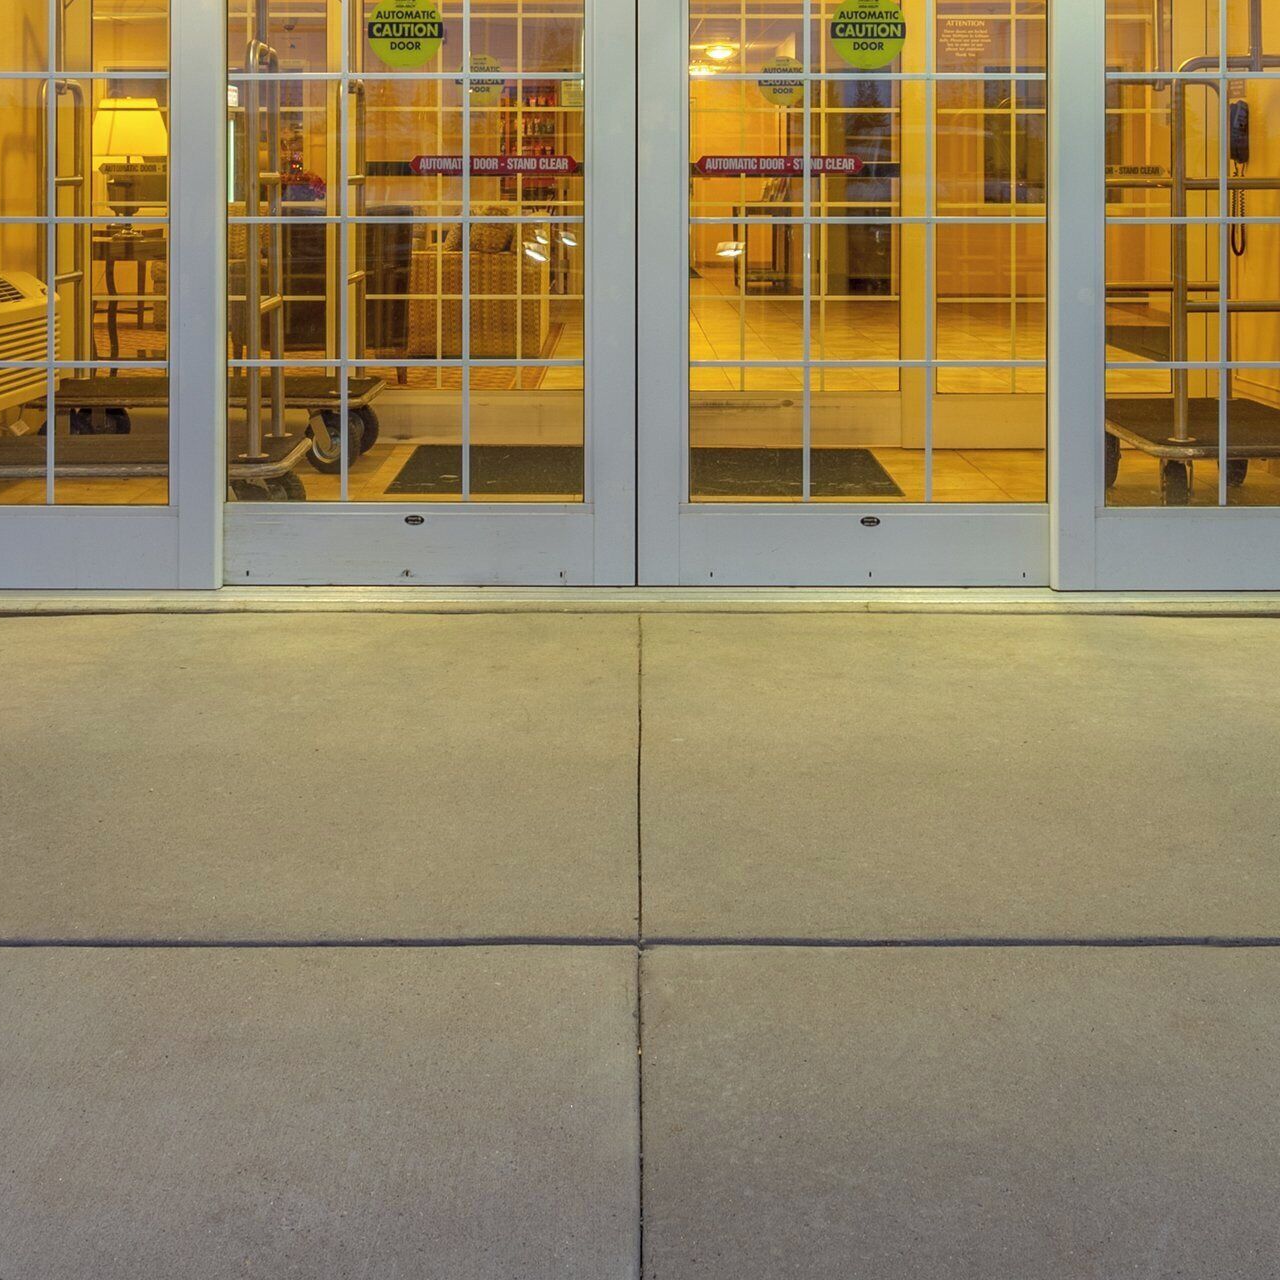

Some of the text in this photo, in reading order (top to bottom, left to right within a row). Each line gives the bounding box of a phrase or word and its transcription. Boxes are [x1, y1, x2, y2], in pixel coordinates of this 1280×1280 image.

[376, 10, 436, 20] AUTOMATIC
[838, 10, 899, 20] AUTOMATIC
[372, 23, 439, 37] CAUTION
[835, 23, 902, 38] CAUTION
[390, 41, 421, 51] DOOR
[853, 41, 884, 51] DOOR
[420, 158, 469, 170] AUTOMAT
[473, 158, 499, 170] DOOR
[507, 158, 537, 170] STAND
[539, 158, 568, 170] CLEAR
[705, 158, 757, 170] AUTOMATIC
[759, 158, 785, 170] DOOR
[793, 158, 823, 170] STND
[825, 158, 855, 170] CLEAR
[1119, 166, 1138, 175] STAND
[1140, 166, 1160, 175] CLEAR
